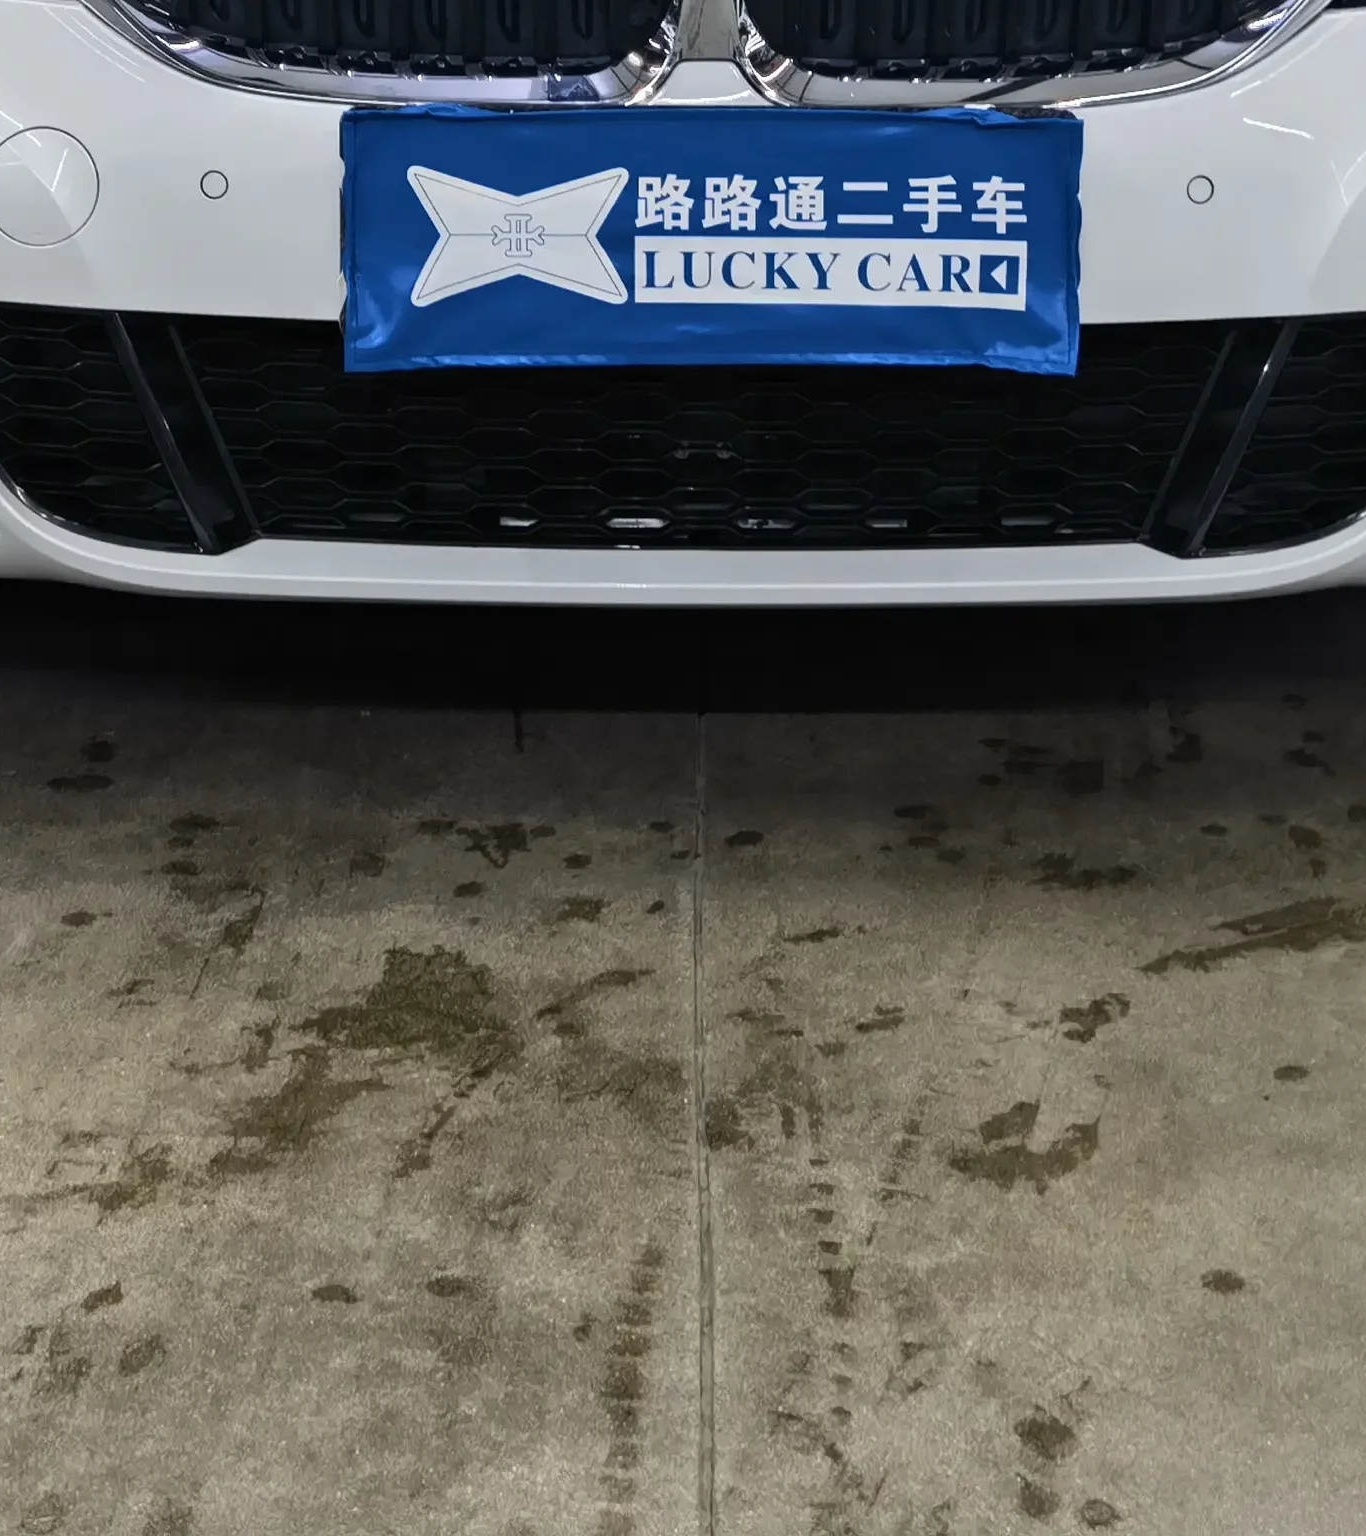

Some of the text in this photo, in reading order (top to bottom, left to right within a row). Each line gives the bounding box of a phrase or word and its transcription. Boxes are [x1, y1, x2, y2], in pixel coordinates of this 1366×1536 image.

[634, 172, 1028, 234] 路路通二手车
[641, 250, 974, 293] LUCKY CAR
